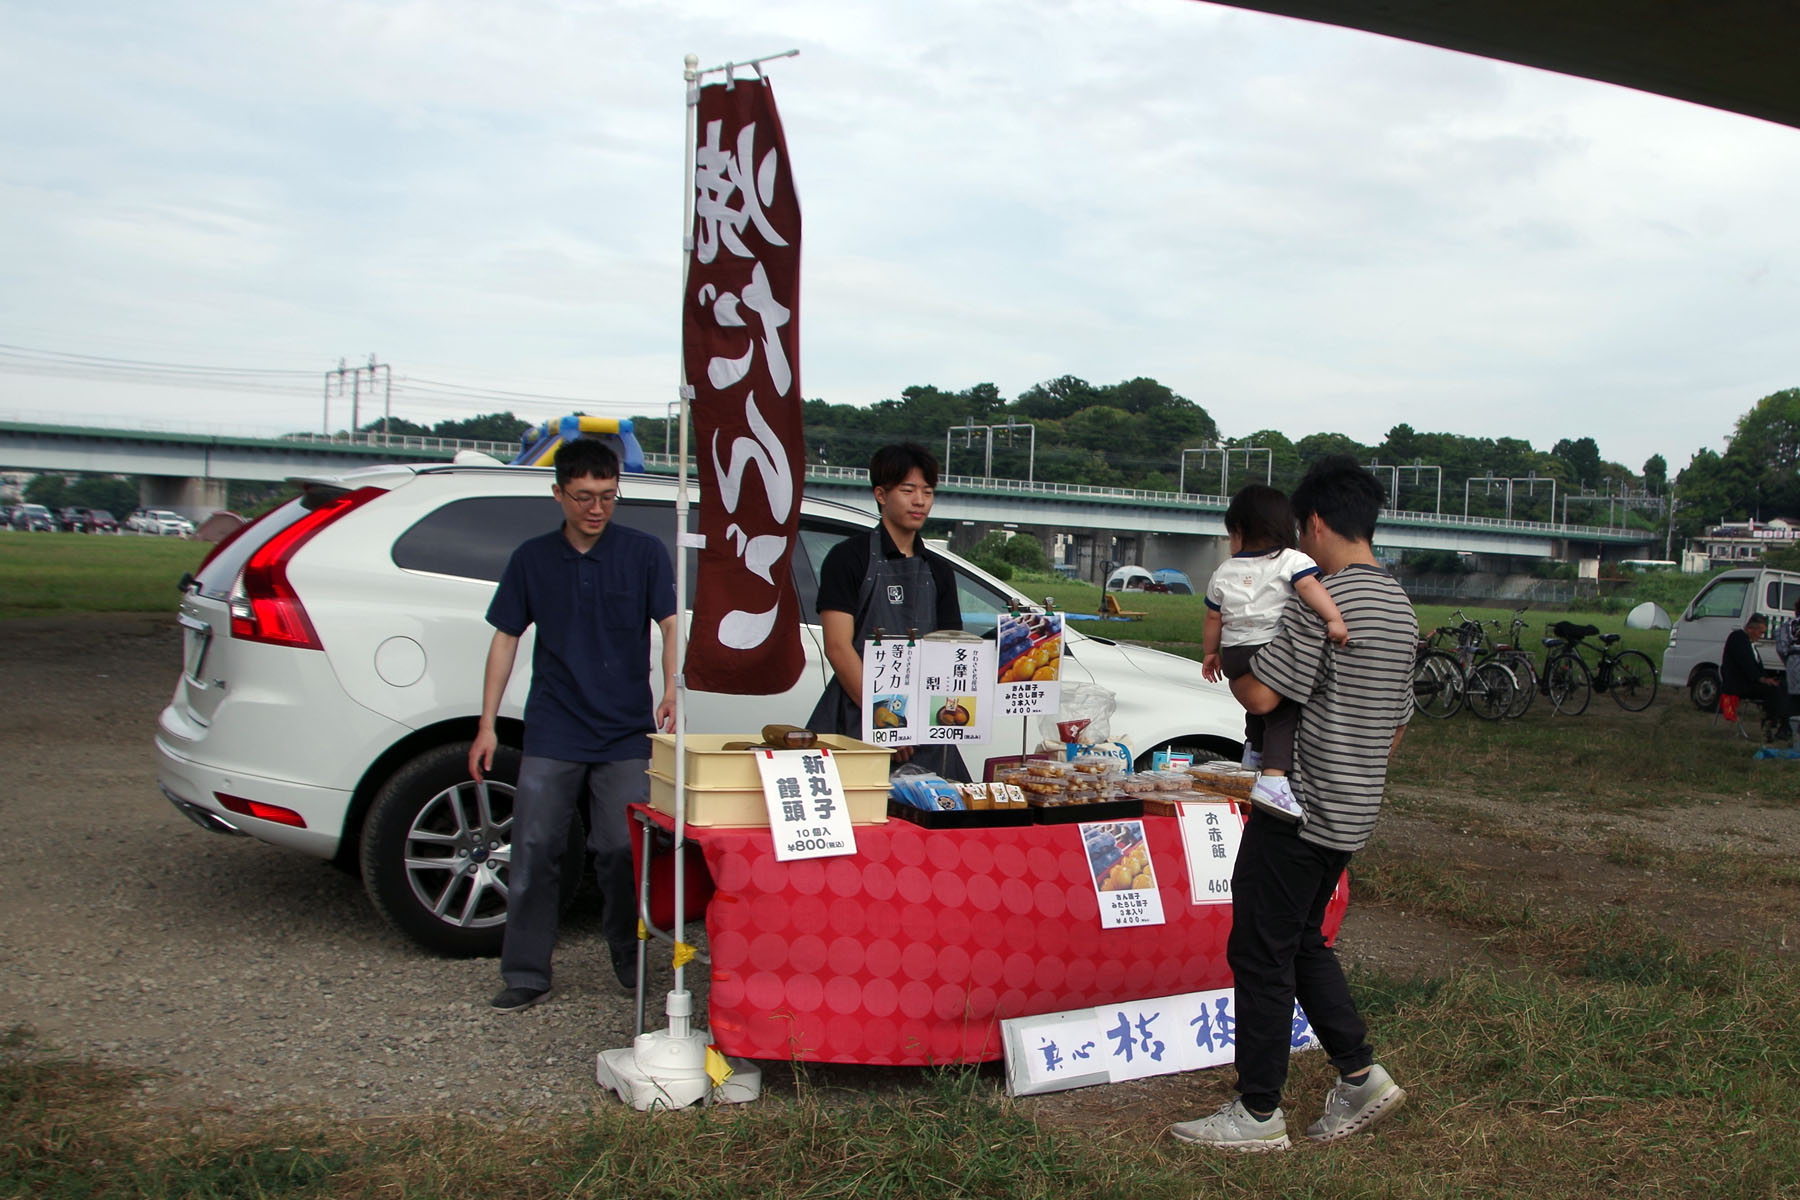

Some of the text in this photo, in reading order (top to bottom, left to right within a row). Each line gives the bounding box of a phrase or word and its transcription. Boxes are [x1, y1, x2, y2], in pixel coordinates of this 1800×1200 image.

[873, 650, 887, 694] サブレ
[889, 643, 905, 689] 等々力
[925, 676, 941, 691] 梨
[952, 648, 968, 693] 多摩川
[776, 777, 807, 822] 饅頭
[802, 754, 836, 820] 新丸子
[1204, 811, 1227, 859] お赤飯
[1208, 878, 1233, 894] 460
